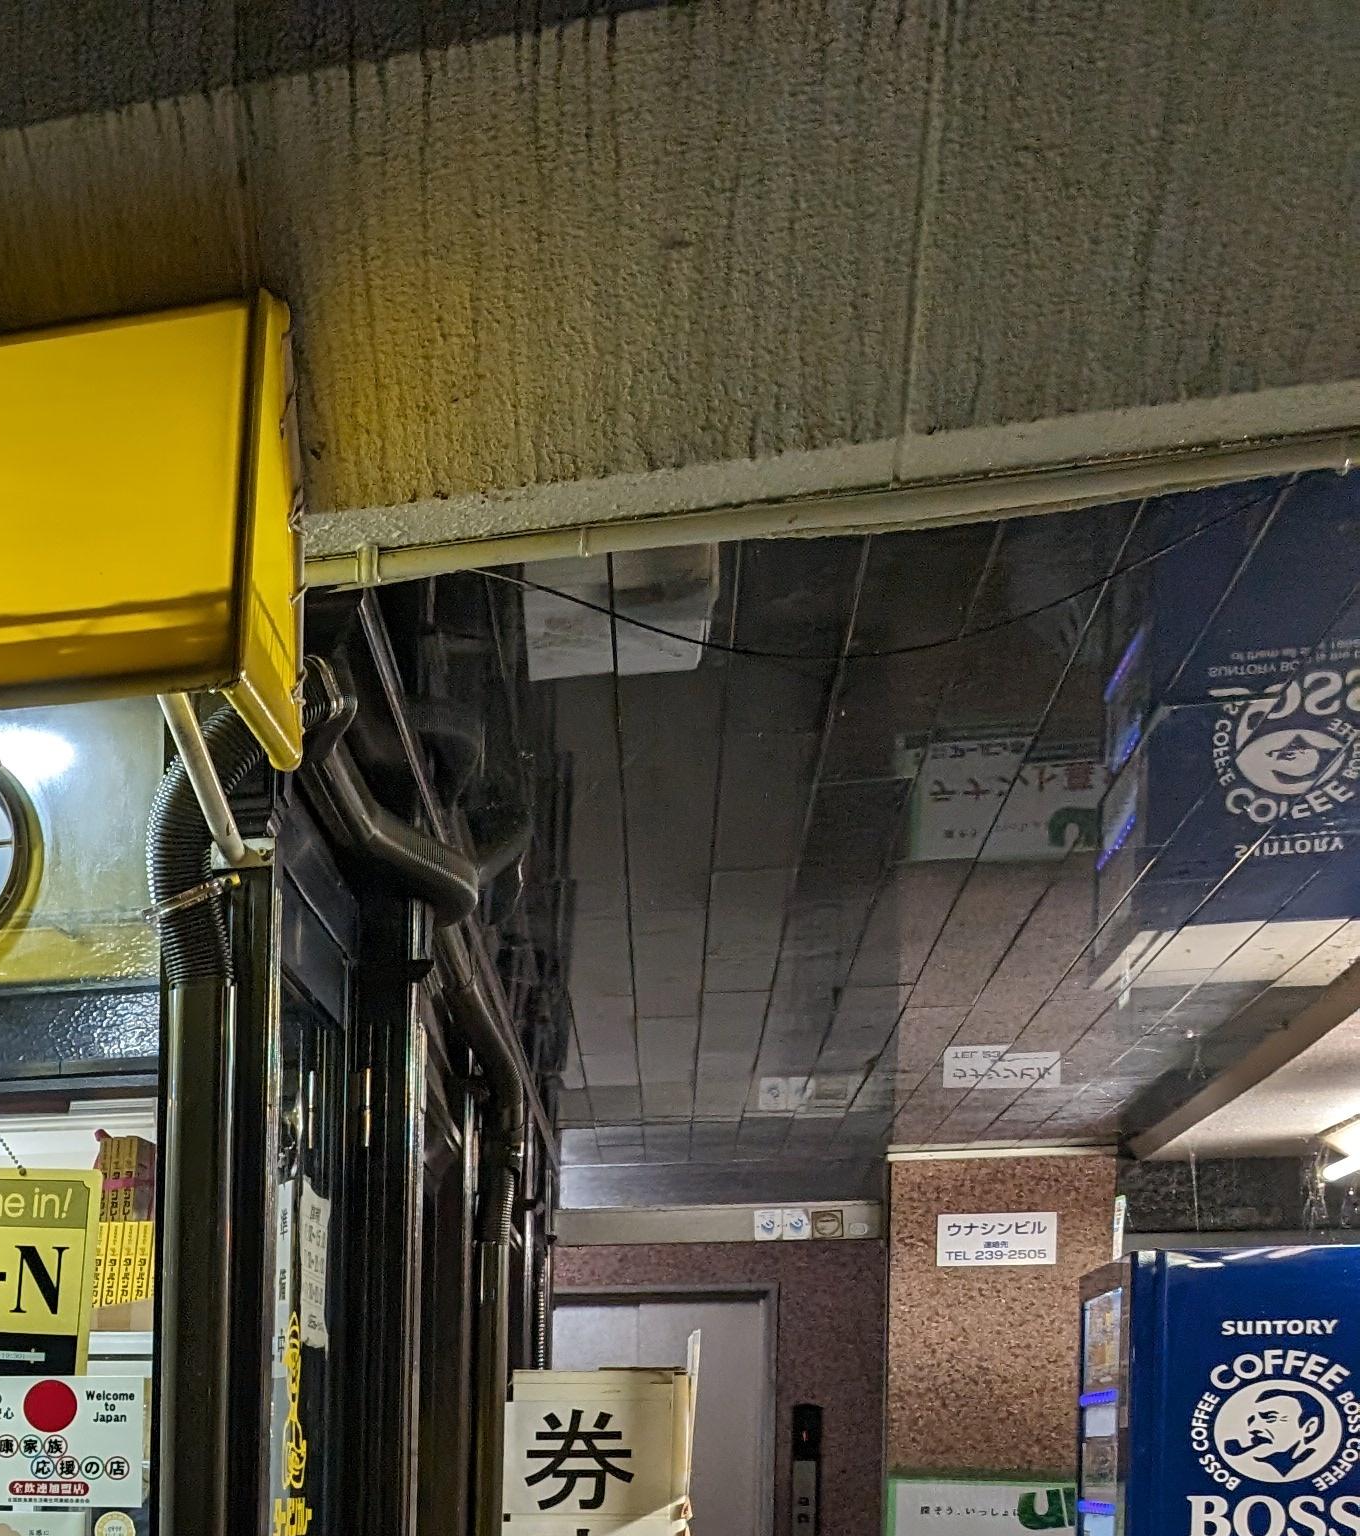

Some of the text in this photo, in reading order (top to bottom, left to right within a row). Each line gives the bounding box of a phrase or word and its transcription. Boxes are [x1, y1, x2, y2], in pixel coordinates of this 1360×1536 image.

[31, 1187, 73, 1220] in!
[947, 1219, 1048, 1238] ウナシンビル
[945, 1248, 1048, 1262] TEL 239-2505
[1221, 1319, 1339, 1336] SUNTORY
[1210, 1349, 1351, 1392] COFFEE
[85, 1390, 135, 1401] Welcome
[104, 1402, 116, 1412] to
[92, 1412, 127, 1424] Japan
[1190, 1390, 1242, 1492] BOSS COFFEE
[33, 1459, 127, 1477] 応援の店
